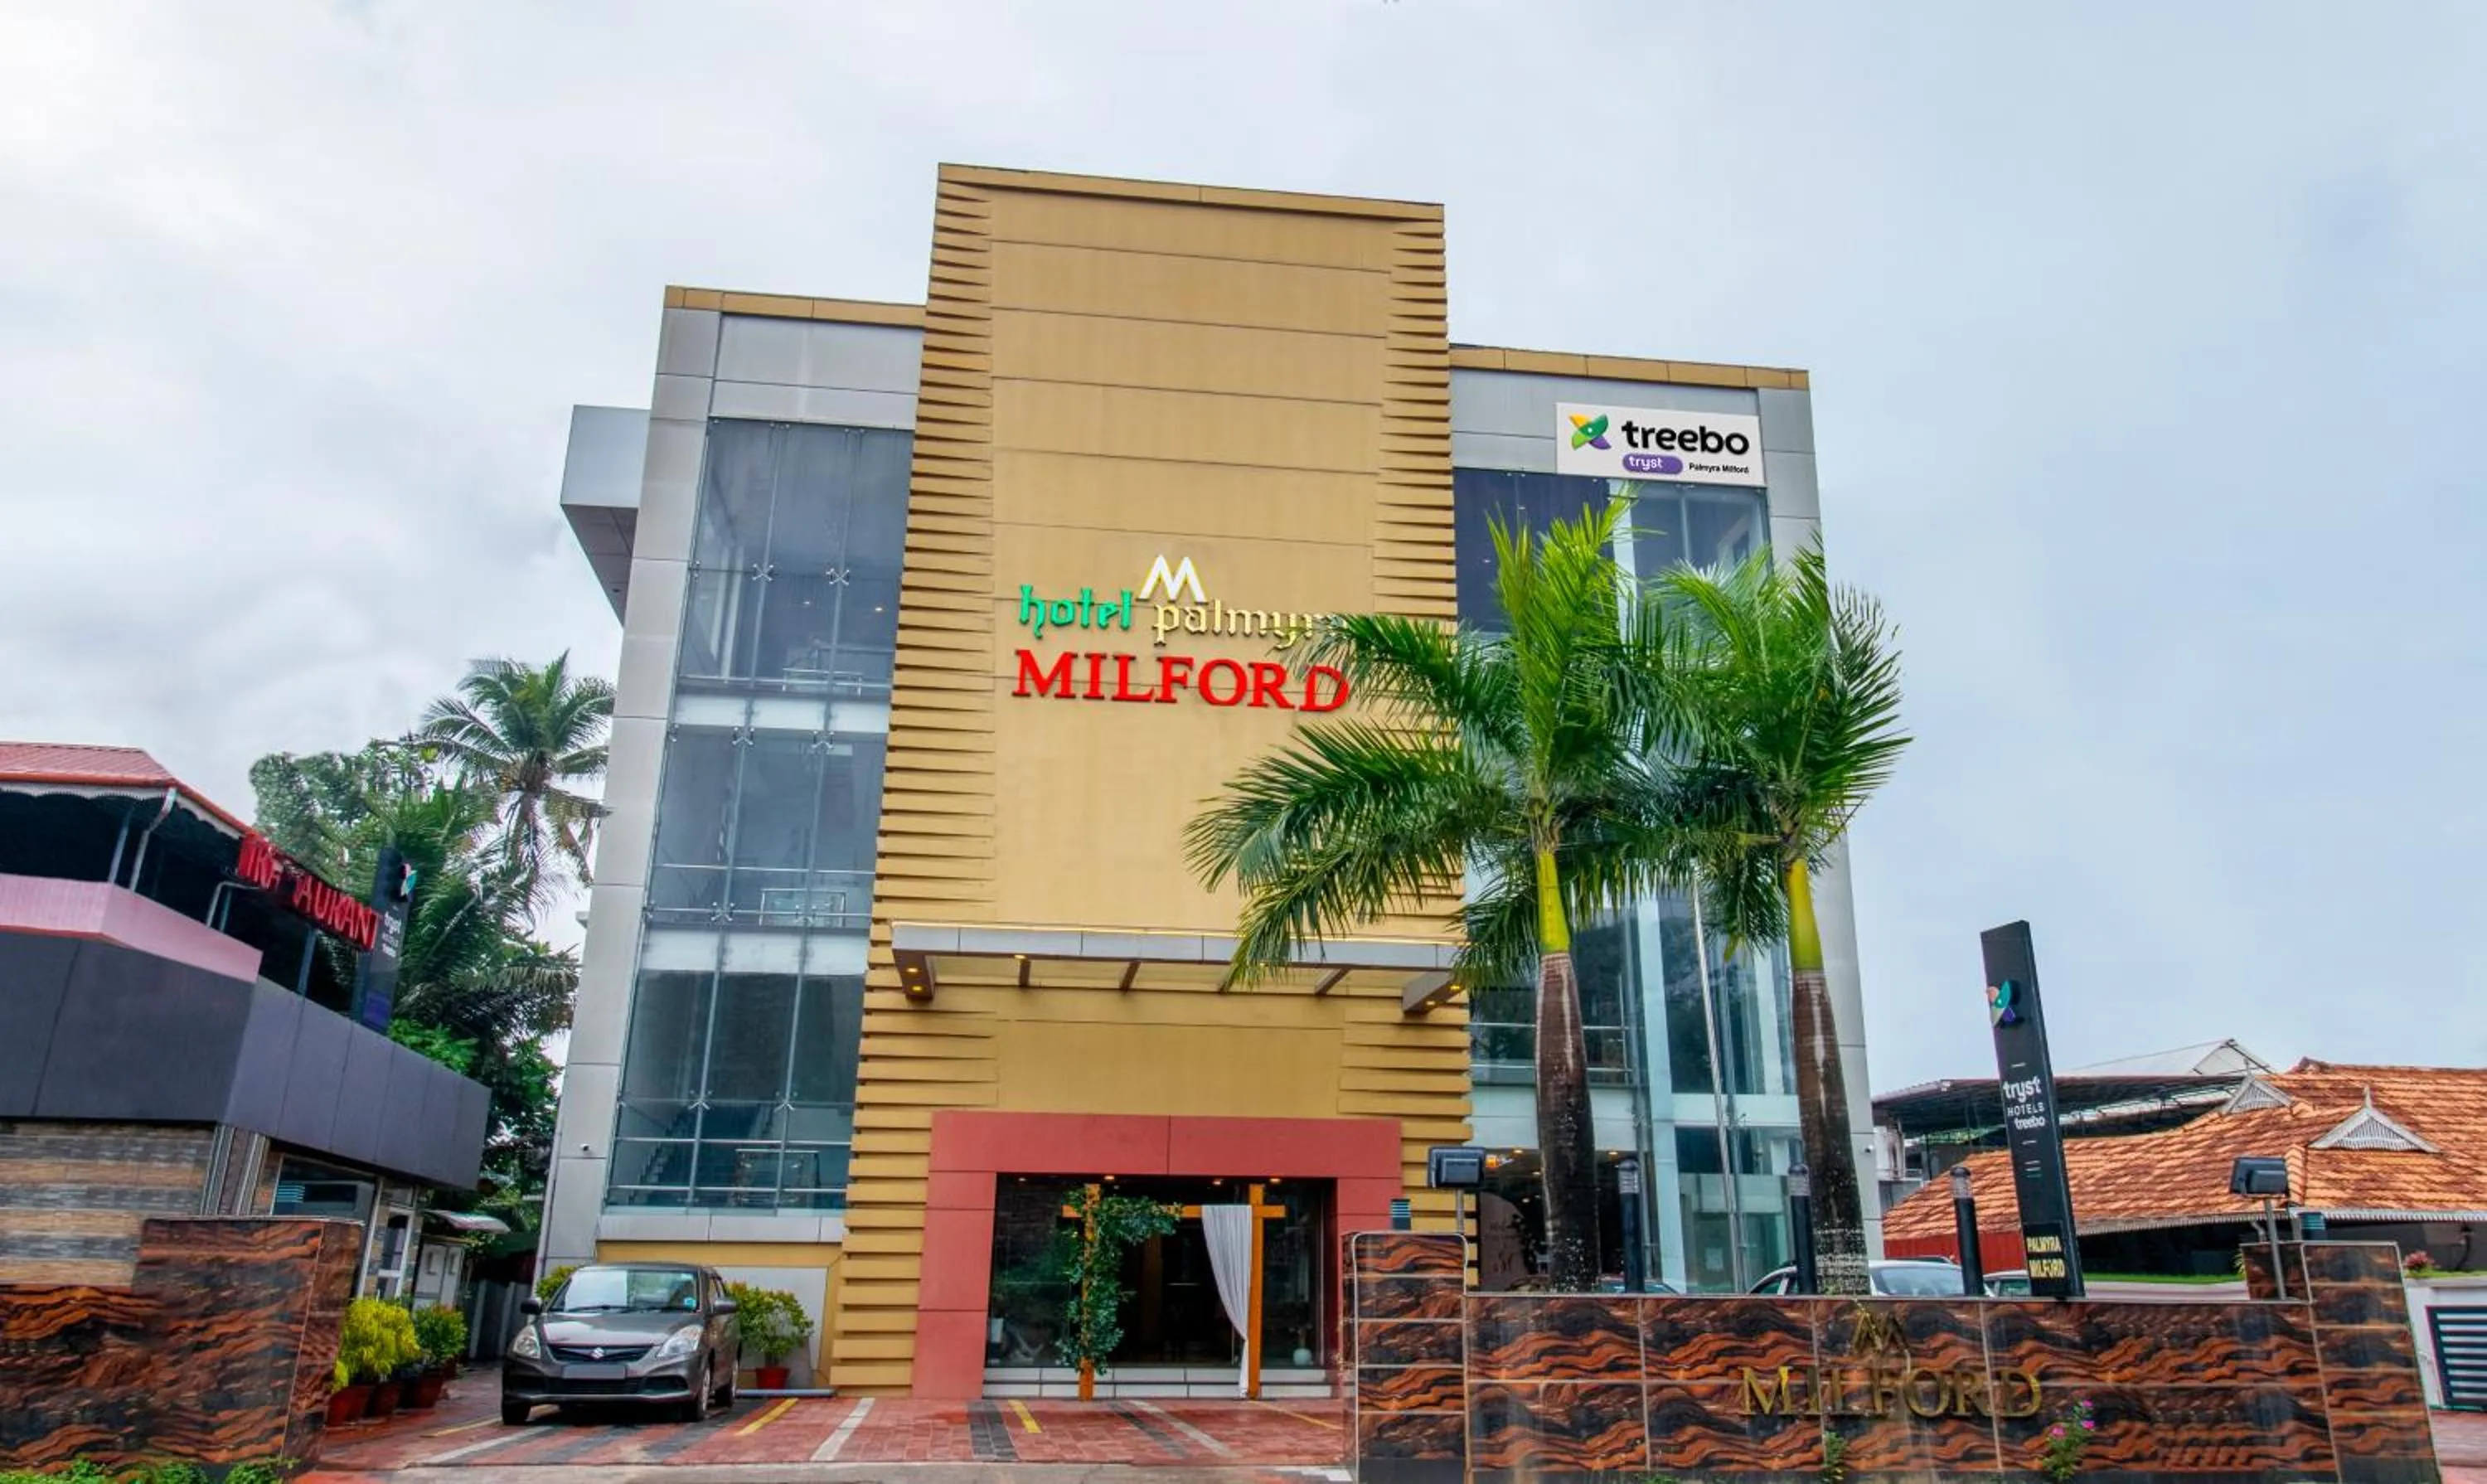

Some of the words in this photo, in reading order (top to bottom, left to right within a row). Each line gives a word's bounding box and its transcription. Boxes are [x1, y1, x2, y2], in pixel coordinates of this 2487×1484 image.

[1621, 420, 1750, 455] treebo
[1628, 456, 1664, 470] tryst
[1689, 462, 1720, 473] Palmyra
[1722, 463, 1750, 474] Milford
[1019, 584, 1133, 640] hotel
[1151, 599, 1336, 650] palmyr
[1011, 648, 1350, 713] MILFORD
[2002, 1075, 2043, 1103] tryst
[2007, 1102, 2045, 1117] HOTELS
[2014, 1115, 2046, 1130] treebo
[1738, 1365, 2043, 1418] MILFORD
